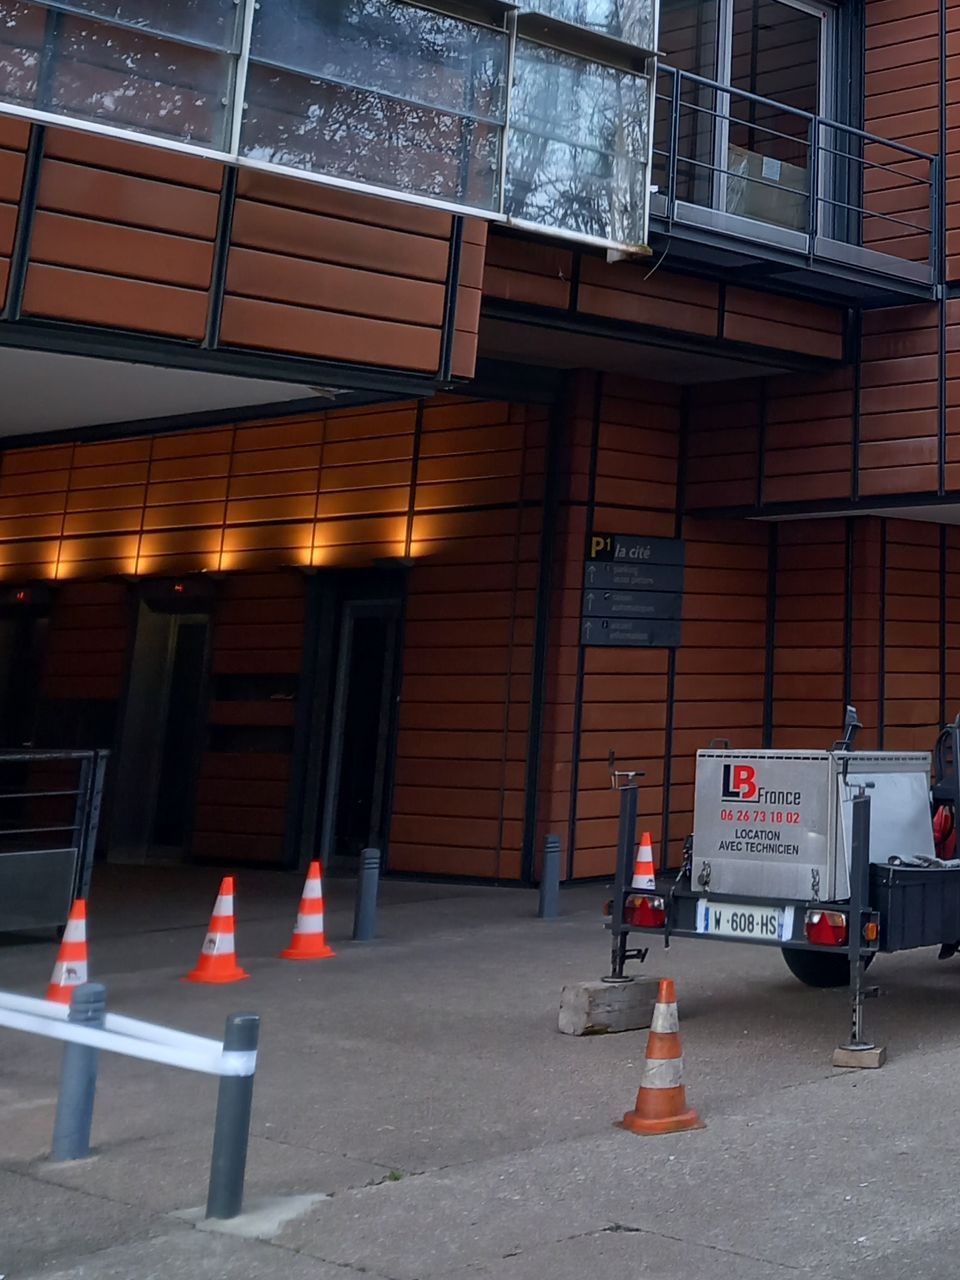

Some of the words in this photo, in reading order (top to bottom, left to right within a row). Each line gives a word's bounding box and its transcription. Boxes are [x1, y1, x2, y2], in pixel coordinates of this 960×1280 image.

[614, 544, 626, 558] la
[629, 545, 651, 559] cité
[722, 764, 757, 799] LB
[758, 787, 801, 806] France
[720, 809, 734, 821] 06
[737, 810, 750, 822] 26
[753, 810, 766, 823] 73
[786, 812, 800, 824] 02
[735, 828, 780, 841] LOCATION
[718, 840, 743, 852] AVEC
[745, 842, 799, 855] TECHNICIEN
